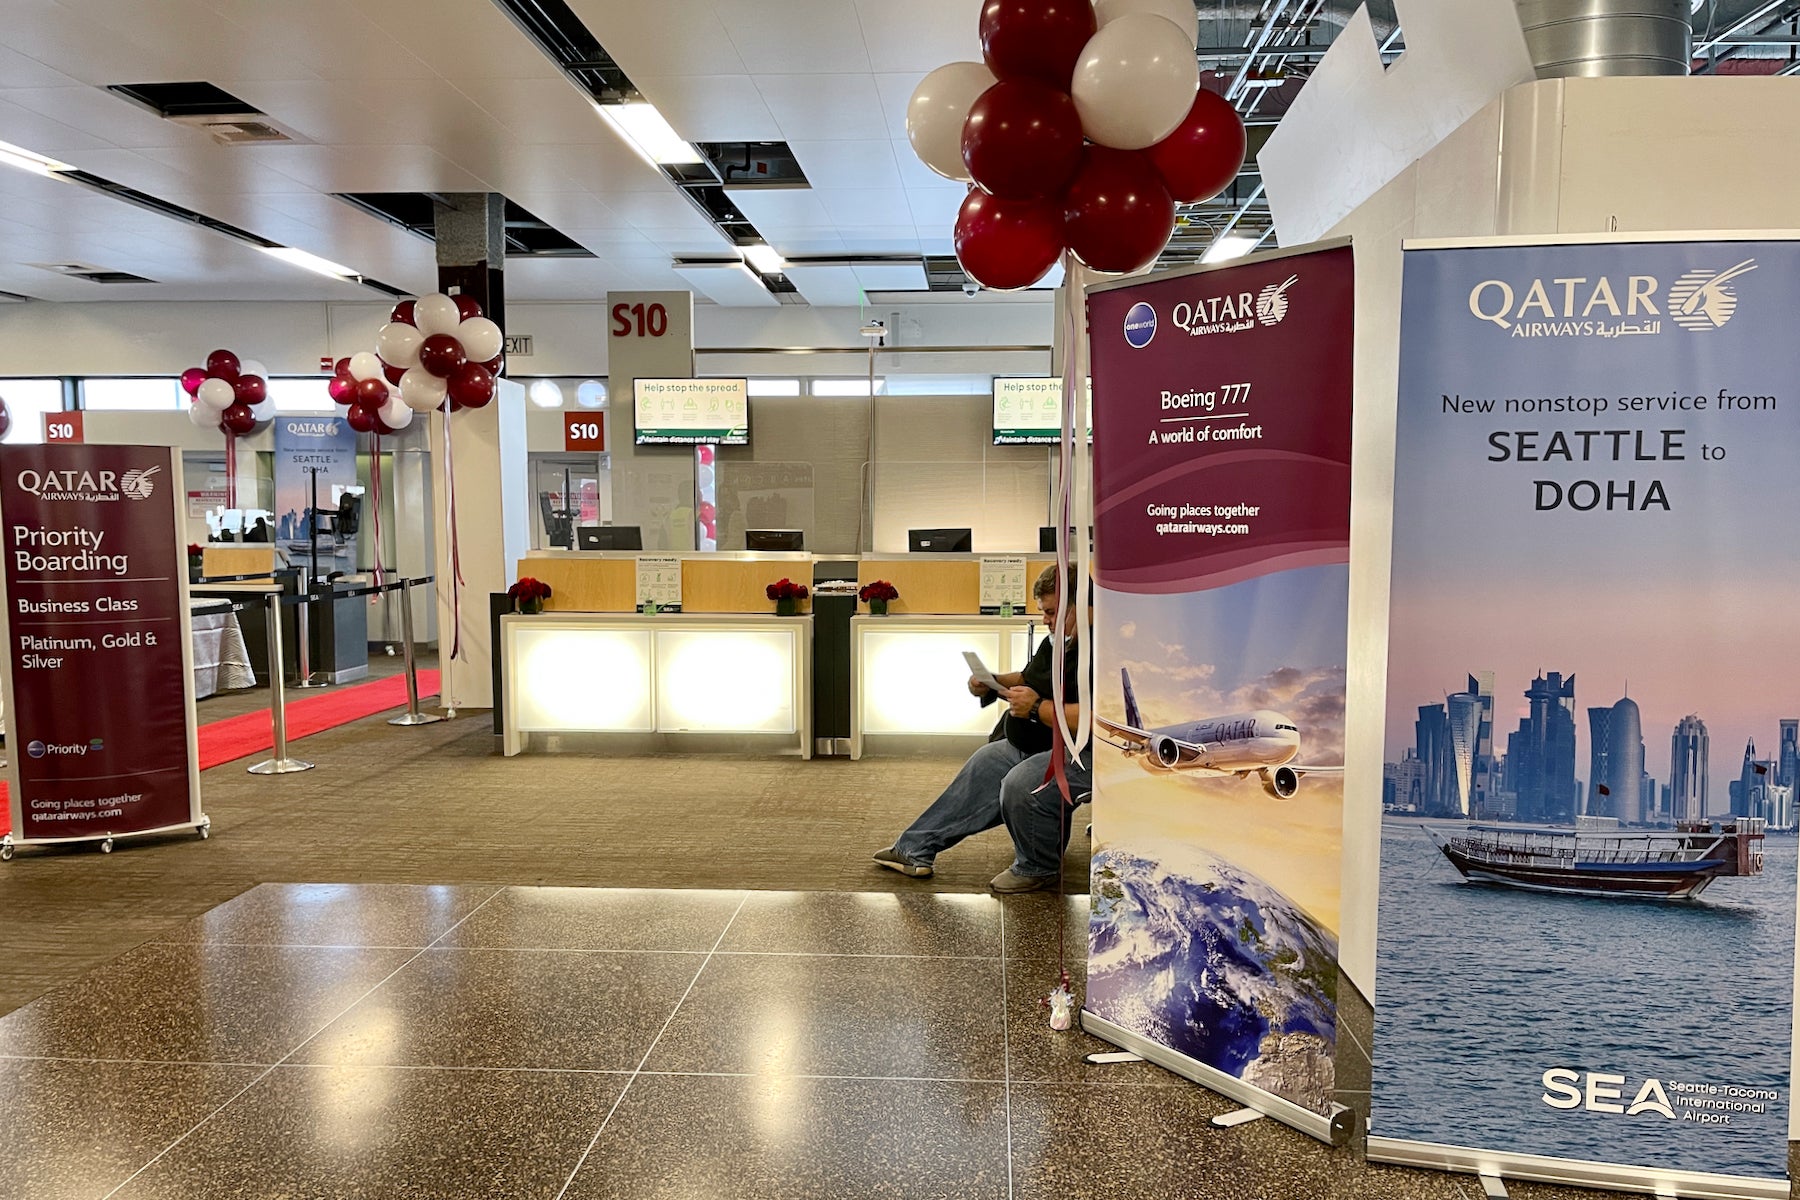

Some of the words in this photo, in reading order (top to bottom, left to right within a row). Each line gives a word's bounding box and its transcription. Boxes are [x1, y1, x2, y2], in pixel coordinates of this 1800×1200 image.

[1469, 275, 1660, 330] QATAR
[612, 303, 668, 337] S10
[1172, 292, 1254, 332] QATAR
[1126, 319, 1155, 331] oneworld
[1189, 322, 1225, 336] AIRWAYS
[1511, 321, 1593, 338] AIRWAYS
[1596, 320, 1661, 338] القطرية
[505, 337, 530, 353] EXIT
[644, 384, 665, 393] Help
[666, 384, 687, 393] stop
[689, 384, 704, 392] the
[1004, 383, 1024, 392] Help
[1026, 384, 1047, 392] stop
[1161, 389, 1216, 411] Boeing
[1220, 383, 1251, 404] 777
[1442, 395, 1495, 413] New
[1505, 395, 1608, 416] nonstop
[1618, 391, 1707, 411] service
[1717, 389, 1776, 411] from
[49, 424, 74, 438] S10
[287, 423, 325, 434] QATAR
[570, 423, 598, 440] S10
[1149, 430, 1158, 444] A
[1161, 427, 1194, 444] world
[1197, 426, 1210, 441] of
[1212, 423, 1262, 441] comfort
[1488, 430, 1686, 462] SEATTLE
[1701, 443, 1726, 461] to
[293, 455, 331, 463] SEATTLE
[18, 470, 118, 496] QATAR
[41, 493, 84, 501] AIRWAYS
[1534, 480, 1671, 511] DOHA
[1147, 504, 1177, 519] Going
[1180, 503, 1211, 518] places
[1214, 503, 1260, 519] together
[1156, 521, 1249, 536] qatarairways.com
[14, 526, 104, 551] Priority
[15, 549, 128, 575] Boarding
[18, 598, 90, 614] Business
[95, 597, 138, 612] Class
[20, 635, 96, 651] Platinum,
[102, 632, 141, 648] Gold
[145, 631, 157, 645] &
[22, 654, 63, 669] Silver
[1215, 719, 1256, 747] QATAR
[47, 744, 87, 755] Priority
[31, 799, 60, 811] Going
[64, 798, 95, 809] places
[98, 792, 143, 807] together
[31, 808, 122, 822] qatarairways.com
[1541, 1068, 1677, 1119] SEA
[1669, 1080, 1778, 1100] Seattle-Tacoma
[1676, 1095, 1765, 1114] International
[1683, 1110, 1731, 1124] Airport
